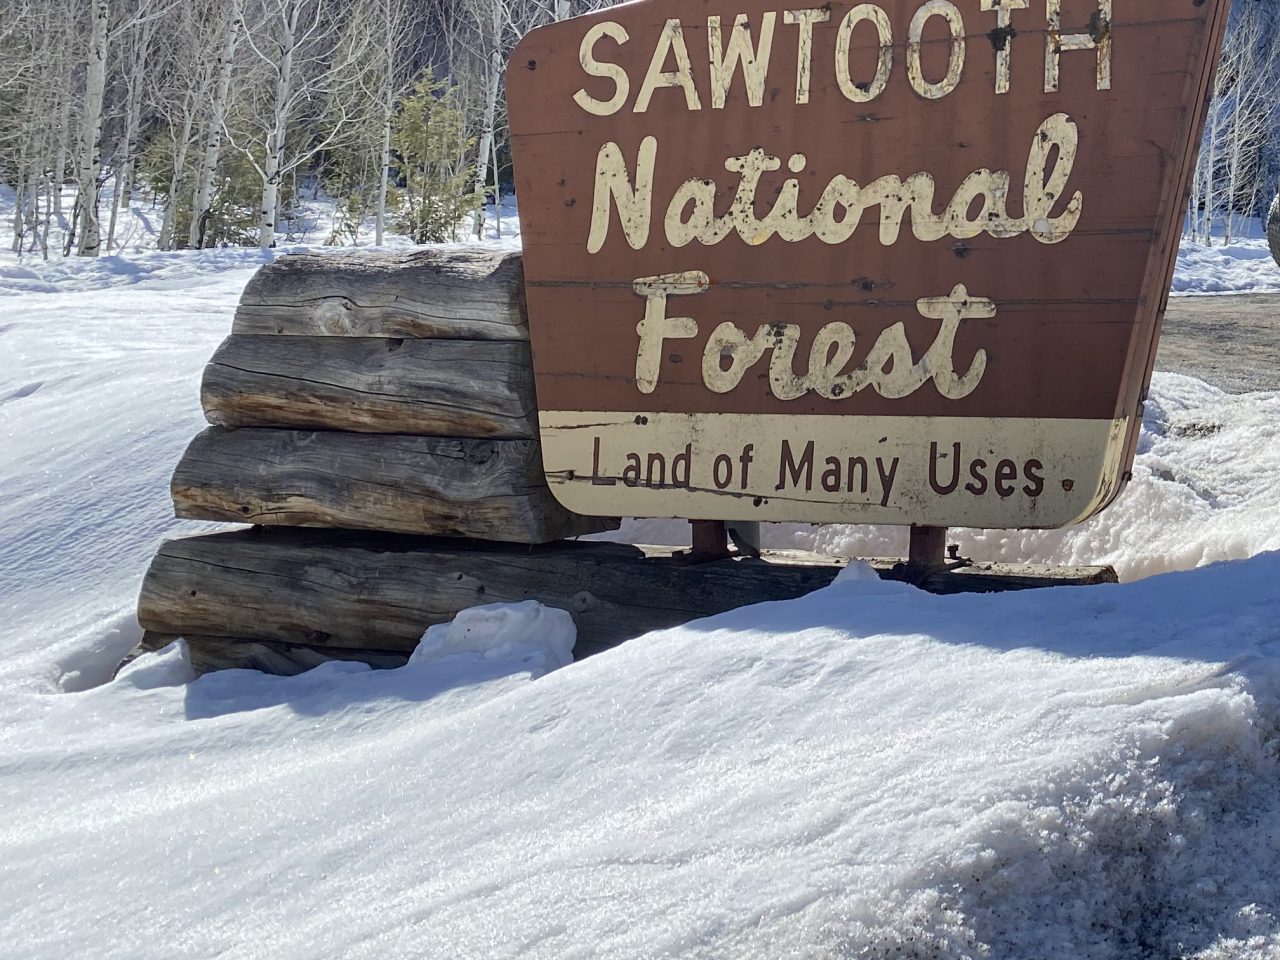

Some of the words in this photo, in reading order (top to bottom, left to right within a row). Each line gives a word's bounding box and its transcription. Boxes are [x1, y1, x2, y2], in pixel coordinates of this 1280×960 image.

[587, 112, 1083, 254] National
[633, 270, 996, 400] Forest
[592, 437, 692, 489] Land
[713, 443, 754, 490] of
[775, 440, 899, 506] Many
[928, 441, 1044, 496] Uses
